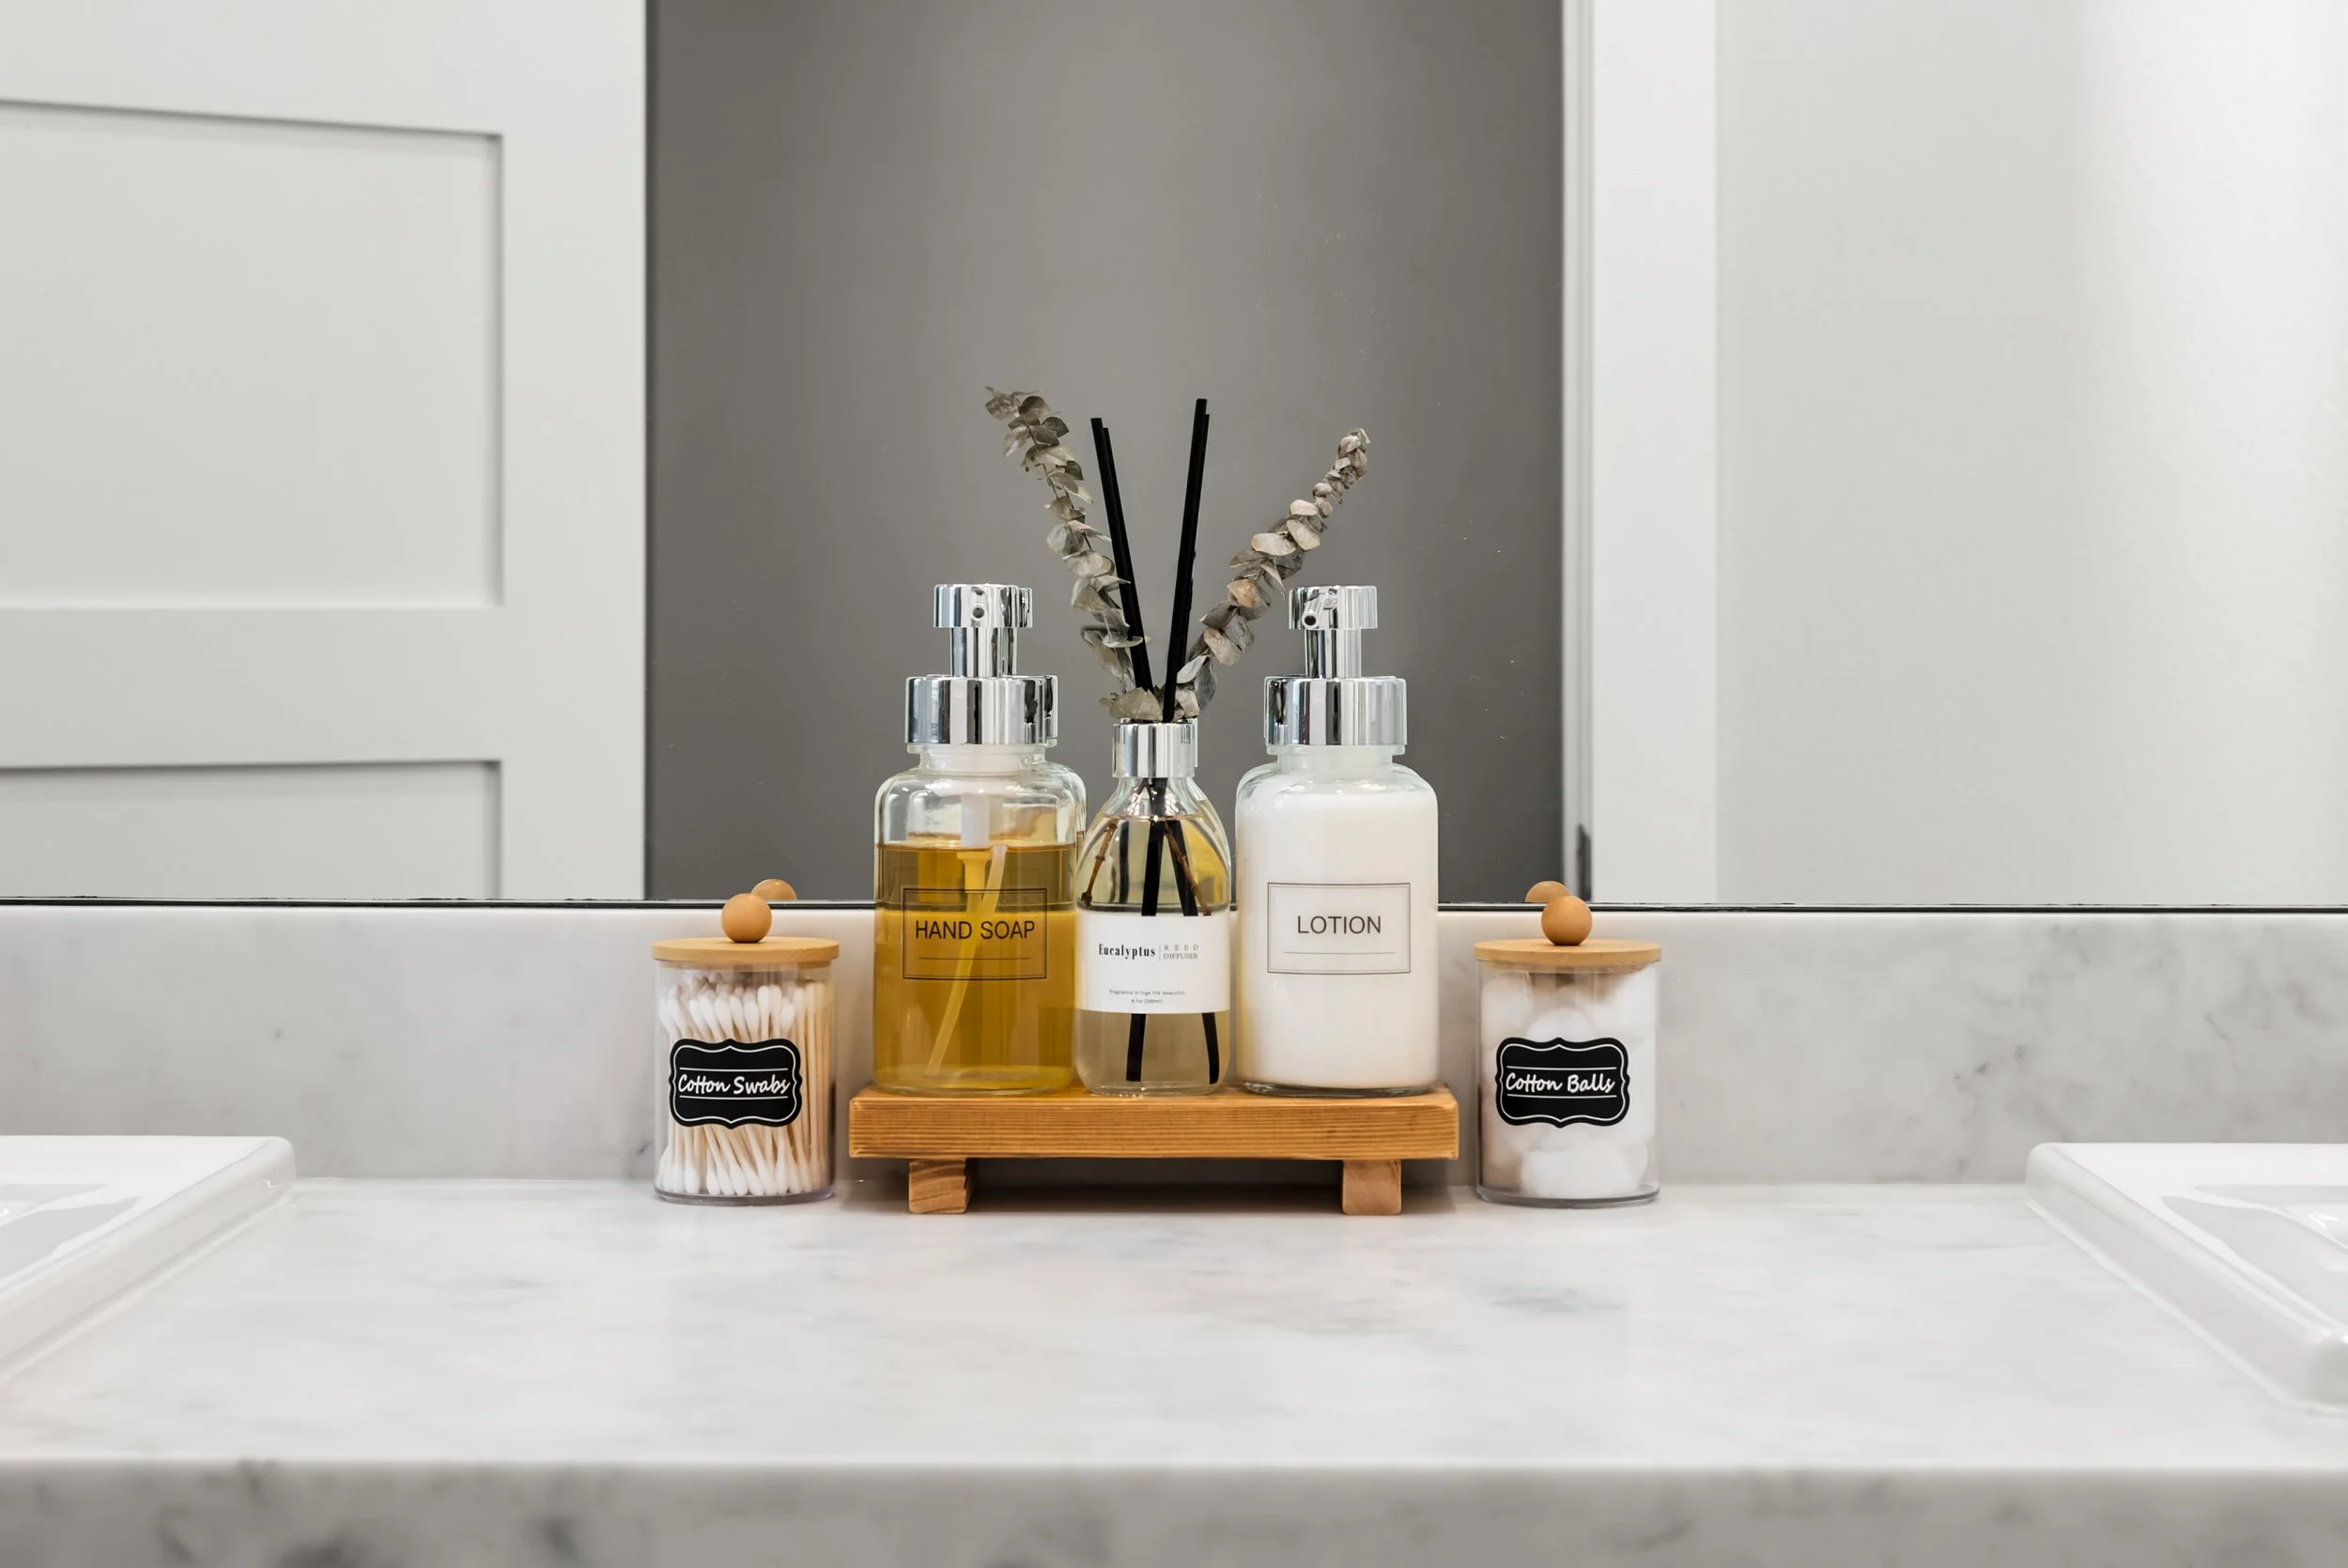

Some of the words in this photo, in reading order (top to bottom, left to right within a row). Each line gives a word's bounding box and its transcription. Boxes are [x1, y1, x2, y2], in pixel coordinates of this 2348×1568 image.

[915, 920, 973, 939] HAND
[980, 920, 1035, 940] SOAP
[1297, 915, 1382, 935] LOTION
[1098, 943, 1156, 960] Eucalyptus
[678, 1073, 731, 1094] Cotton
[734, 1073, 791, 1094] Swabs
[1506, 1072, 1563, 1093] Cotton
[1567, 1072, 1615, 1093] Balls
